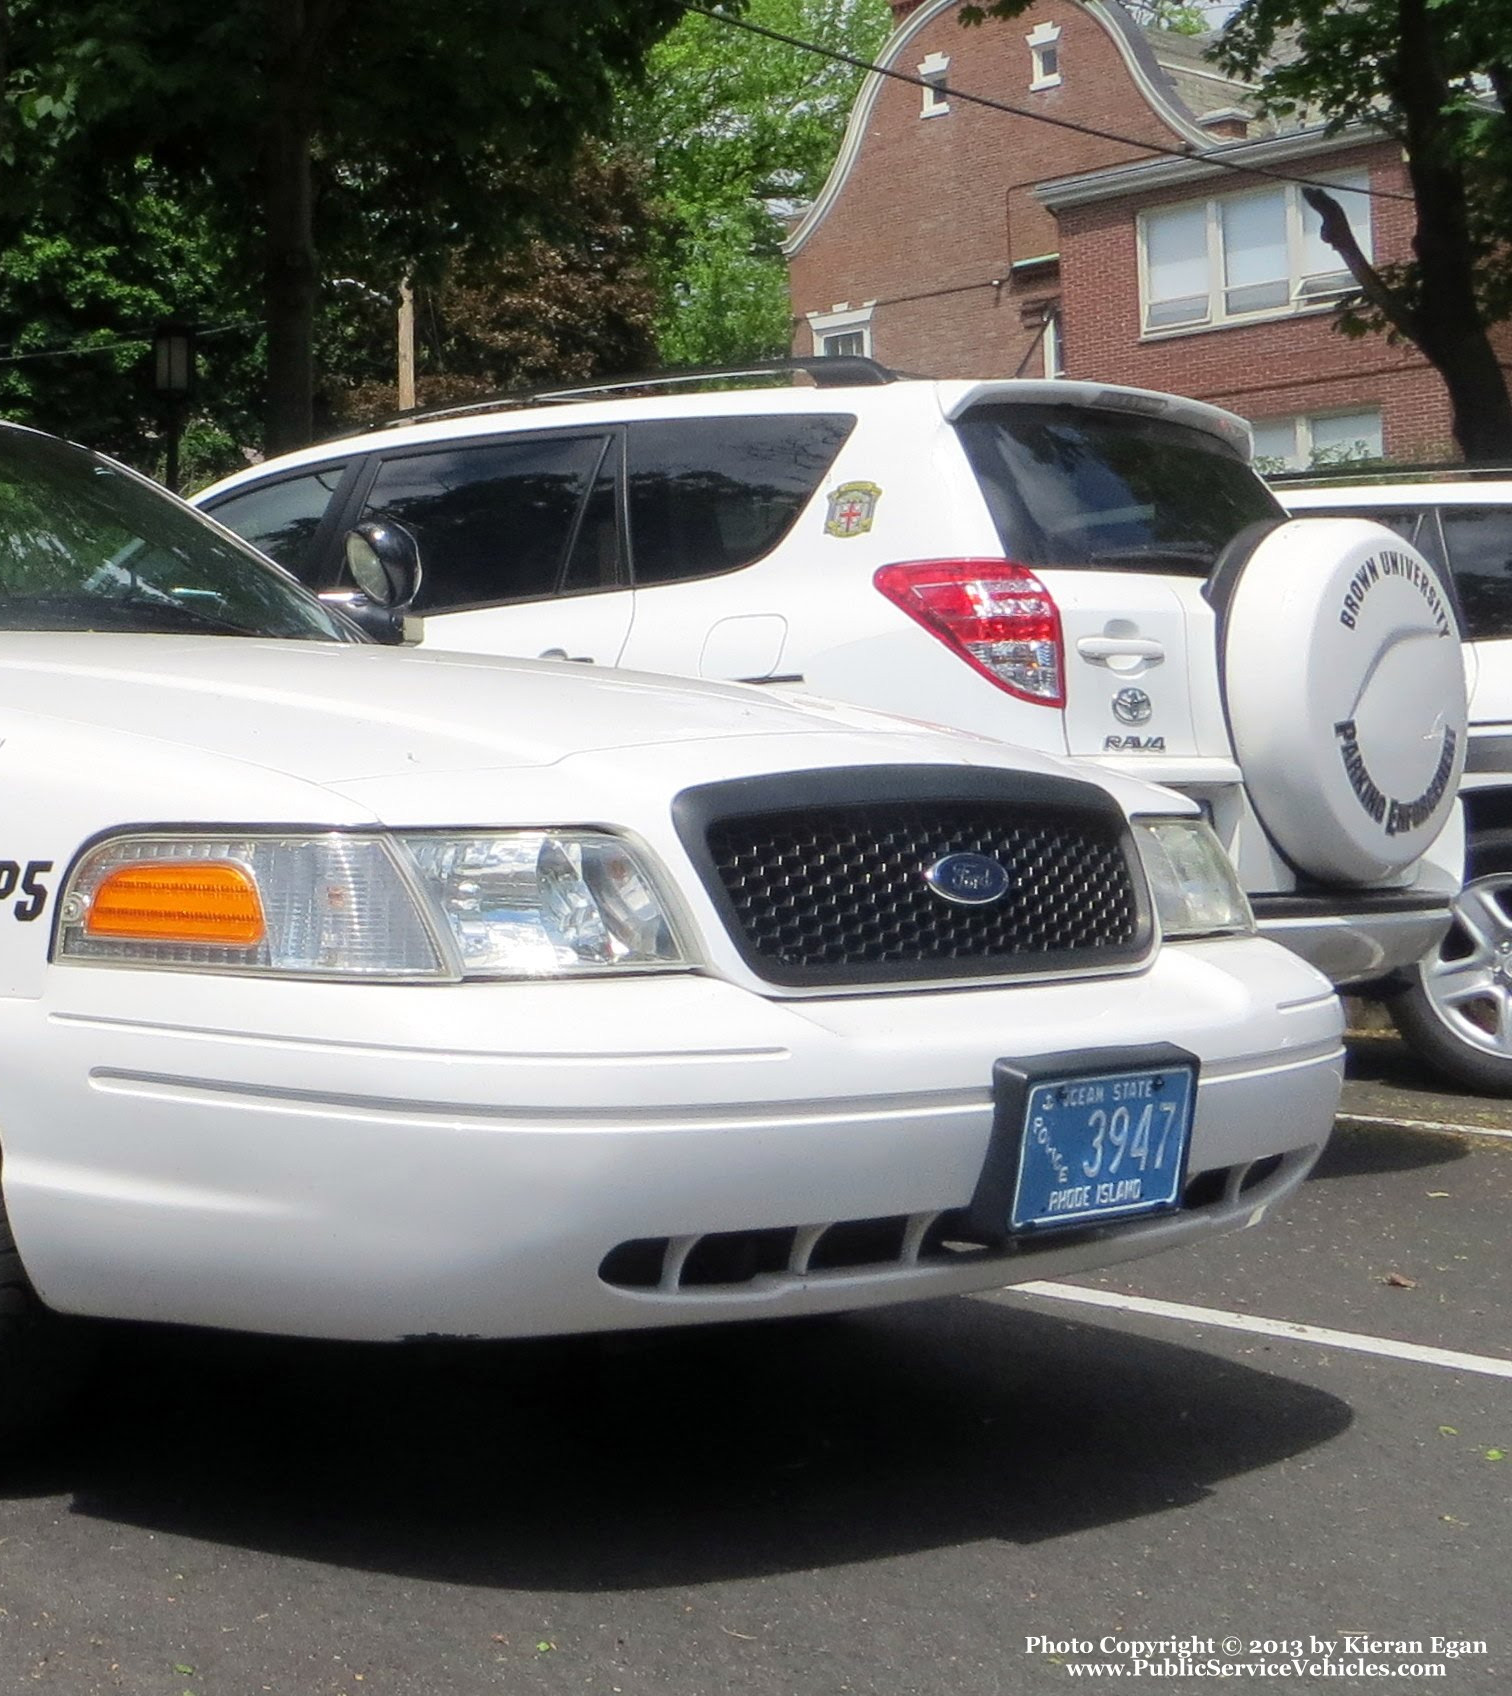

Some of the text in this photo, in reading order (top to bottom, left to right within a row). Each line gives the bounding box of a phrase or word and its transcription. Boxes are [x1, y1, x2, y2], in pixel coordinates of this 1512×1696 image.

[1340, 551, 1451, 638] BROWN UNIVERSITY
[1103, 734, 1166, 752] RAV4
[1334, 720, 1387, 825] PARKING
[1112, 1079, 1154, 1101] STATE
[1082, 1102, 1177, 1178] 3947
[1048, 1178, 1142, 1211] RHODE ISLAND
